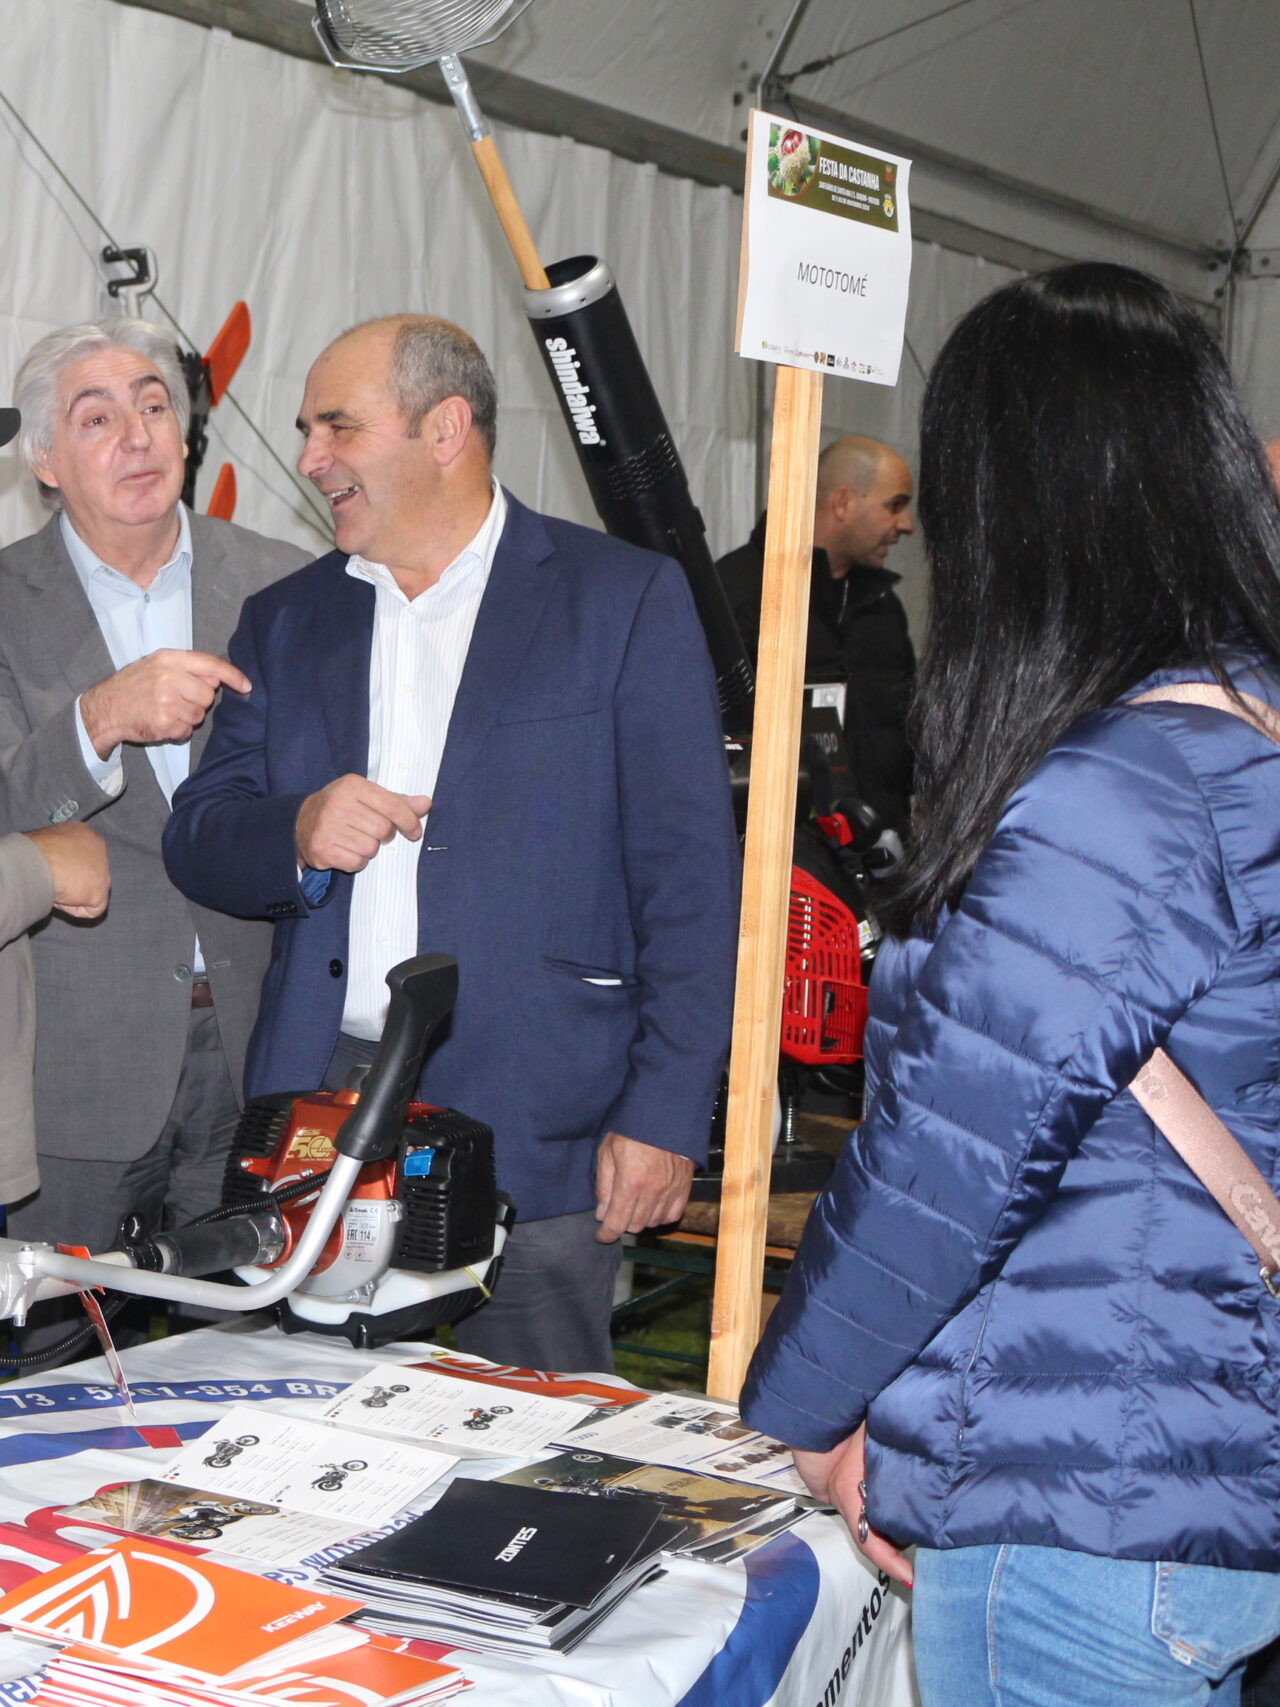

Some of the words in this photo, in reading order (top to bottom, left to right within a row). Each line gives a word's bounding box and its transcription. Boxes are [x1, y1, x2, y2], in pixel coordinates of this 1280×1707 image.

[819, 156, 838, 178] FESTA
[839, 163, 848, 181] DA
[849, 166, 880, 191] CASTANHA
[797, 261, 869, 298] MOTOTOMÉ
[545, 336, 602, 446] shindaiwa
[0, 1392, 55, 1408] 73
[495, 1526, 538, 1562] ZONTES
[260, 1601, 327, 1633] KEEWAY
[816, 1567, 892, 1707] mentos
